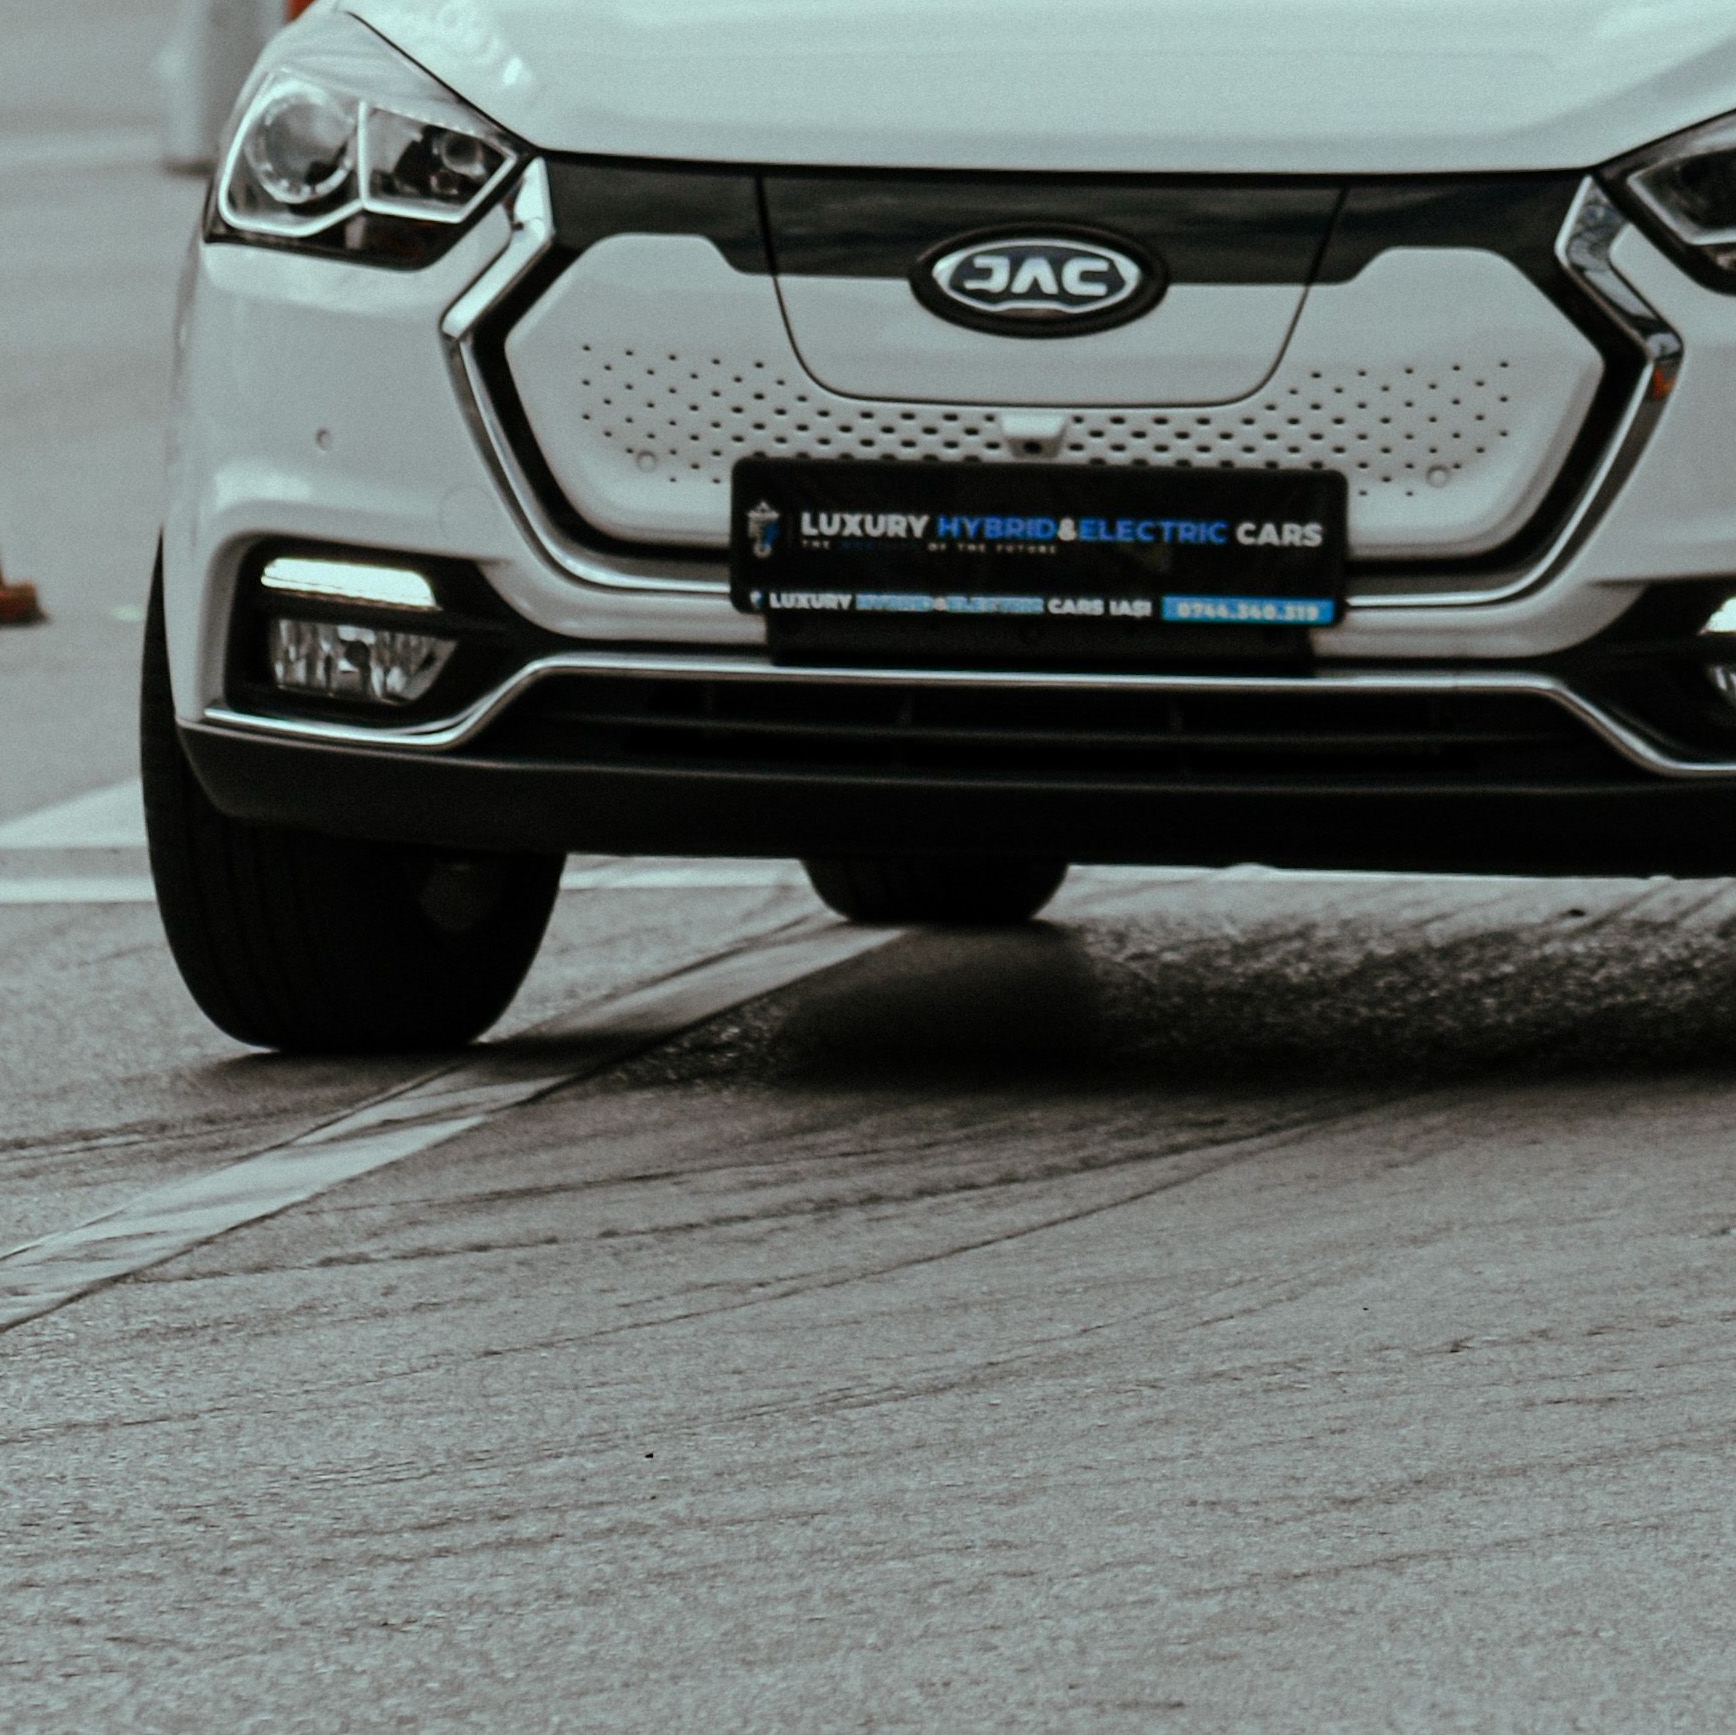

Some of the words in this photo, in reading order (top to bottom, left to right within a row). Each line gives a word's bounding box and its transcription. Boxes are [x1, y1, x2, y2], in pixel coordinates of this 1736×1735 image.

[964, 256, 1109, 296] JAC
[801, 513, 929, 538] LUXURY
[1236, 523, 1323, 547] CARS
[769, 592, 852, 610] LUXURY
[1047, 599, 1104, 616] CARS
